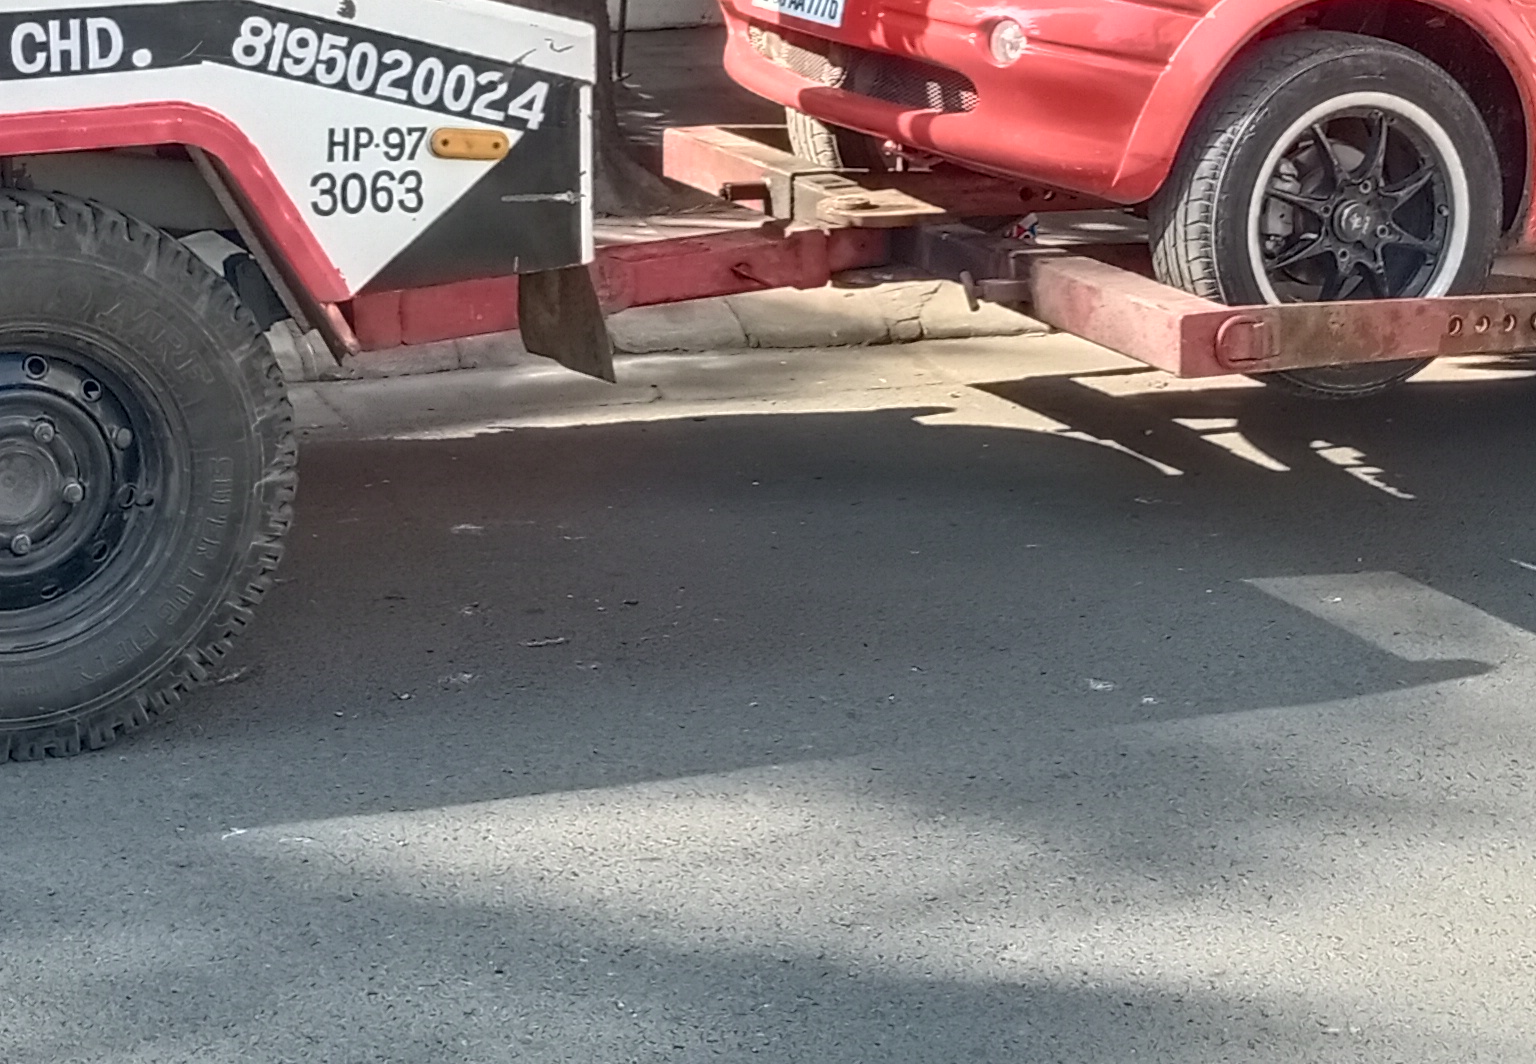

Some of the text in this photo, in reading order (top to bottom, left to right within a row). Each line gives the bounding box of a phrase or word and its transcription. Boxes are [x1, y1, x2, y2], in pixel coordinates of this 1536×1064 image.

[10, 16, 152, 75] CHD.
[232, 15, 552, 133] 8195020024
[309, 171, 426, 216] 3063
[95, 294, 215, 384] MRF
